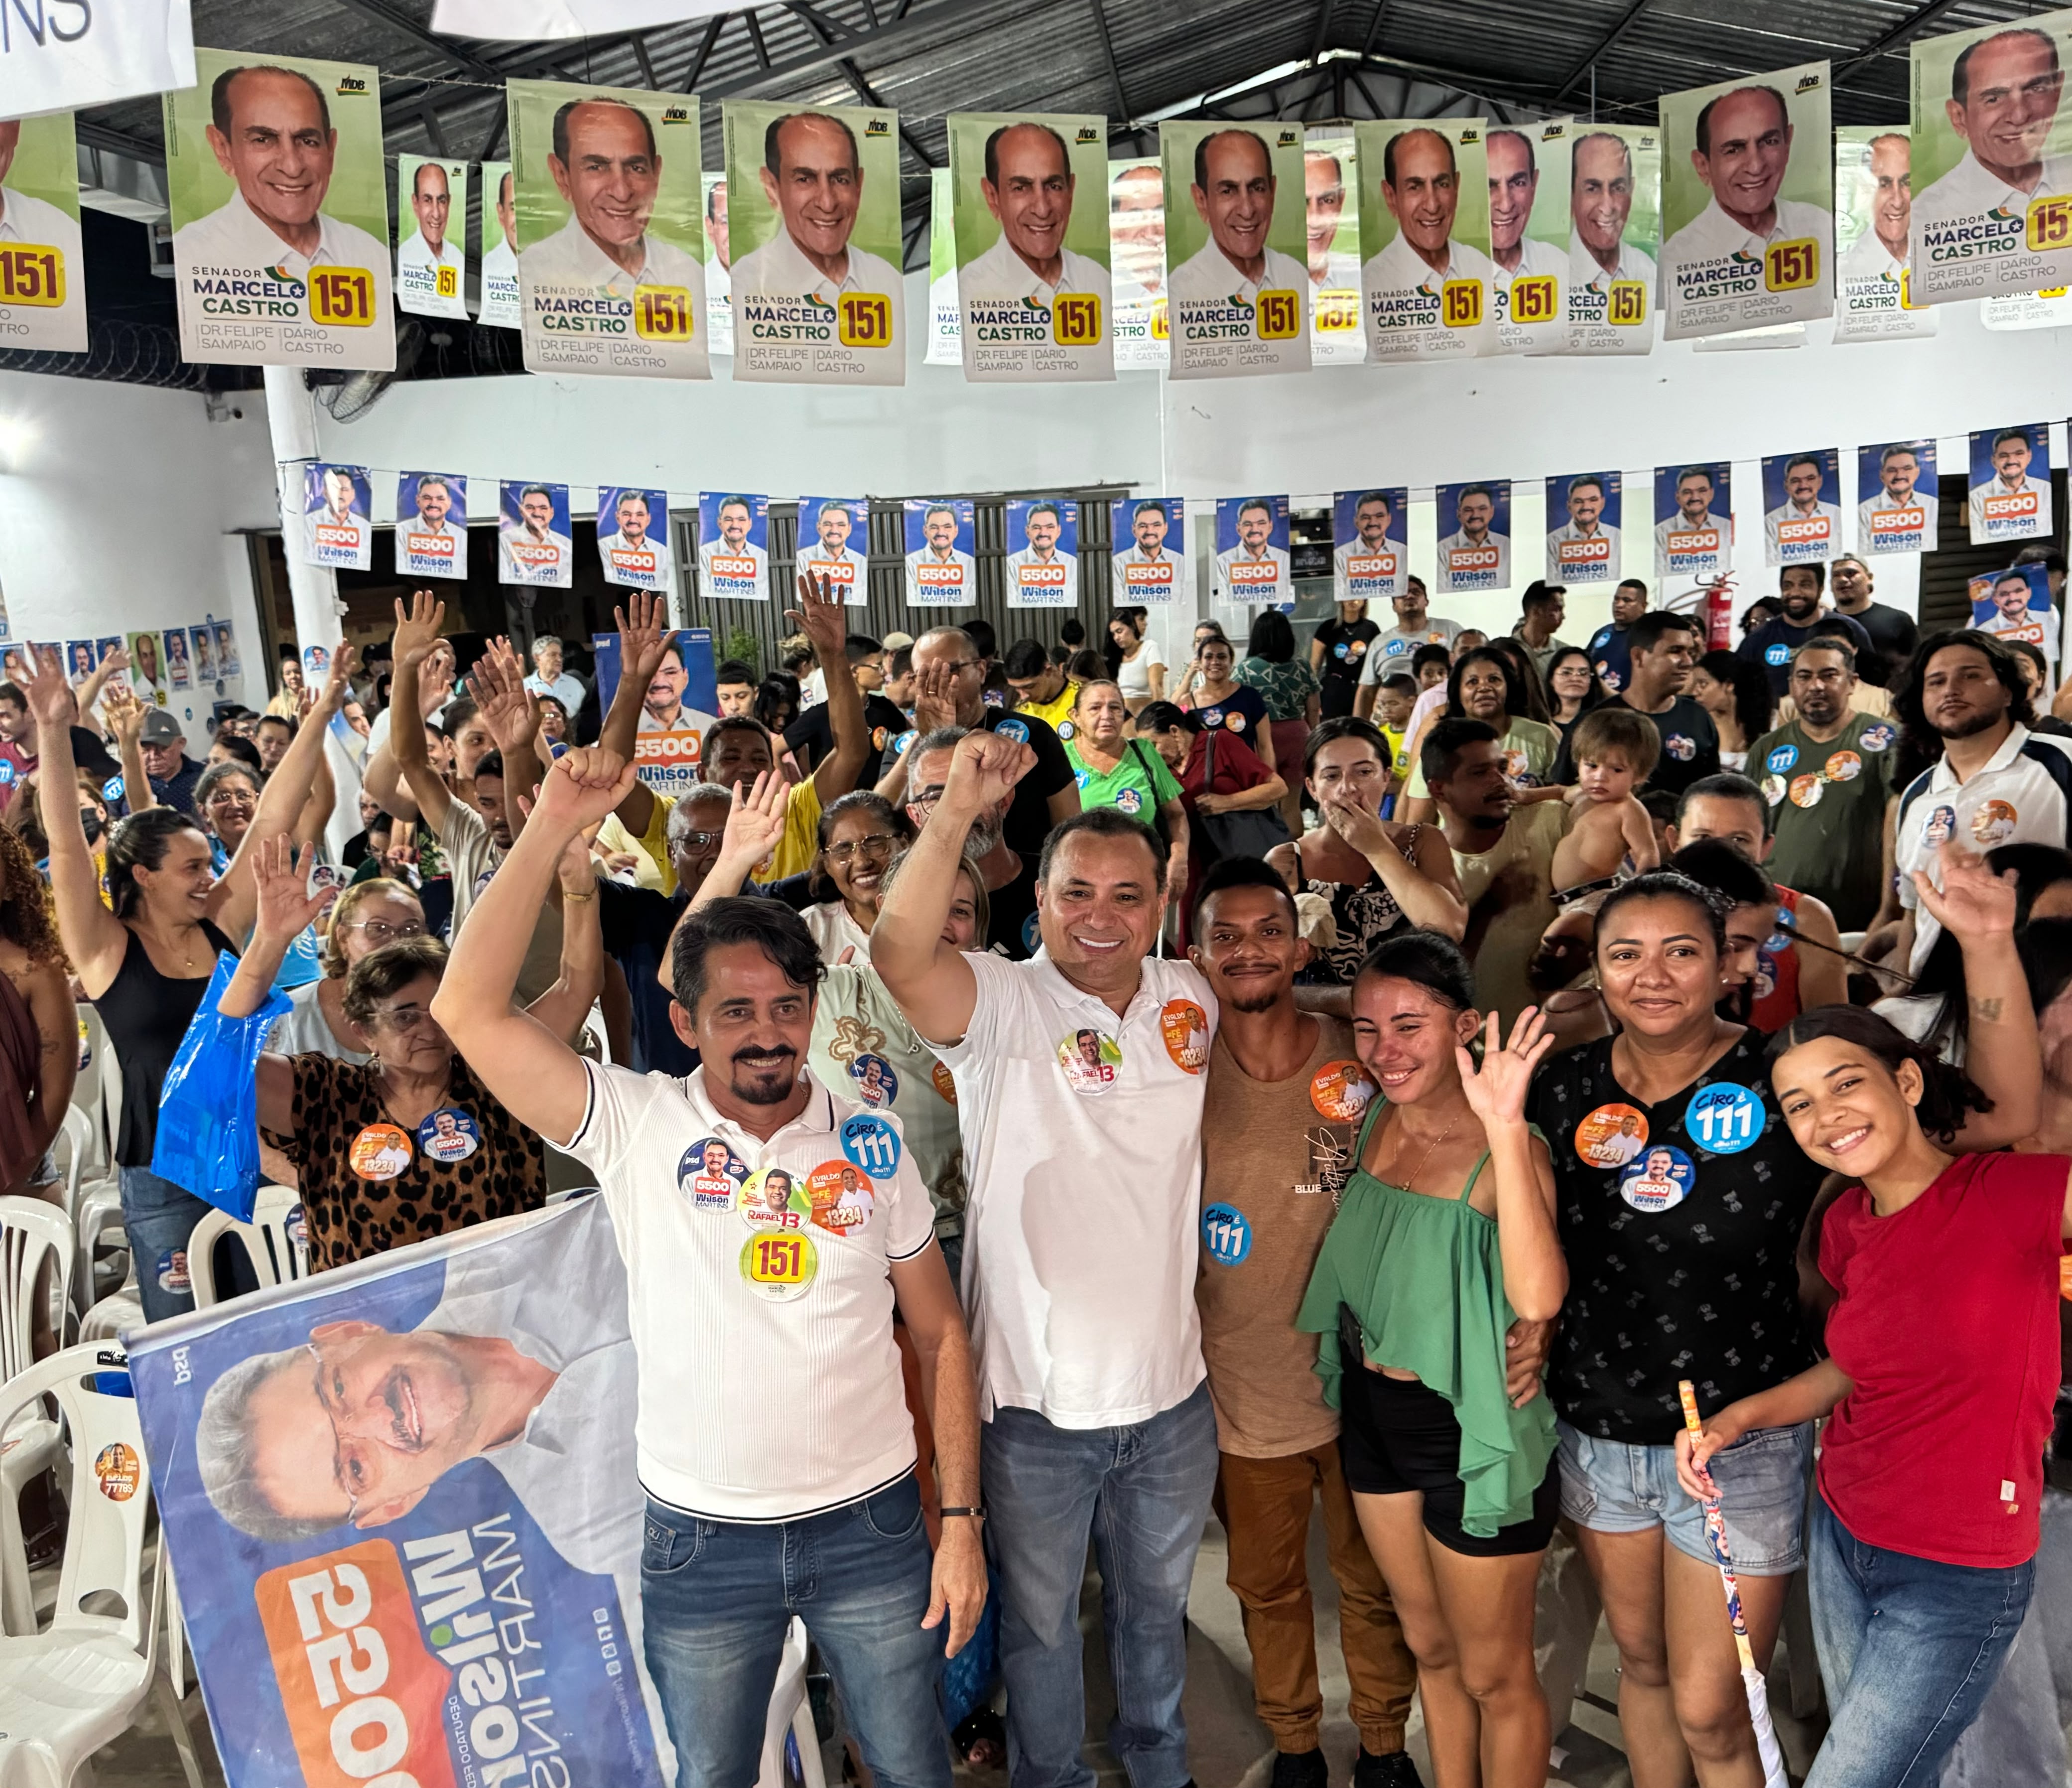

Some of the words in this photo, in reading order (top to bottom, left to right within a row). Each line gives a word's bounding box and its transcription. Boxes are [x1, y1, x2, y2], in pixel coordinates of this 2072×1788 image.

[341, 78, 365, 91] MDB
[1799, 75, 1819, 89] MDB
[665, 108, 687, 120] MDB
[868, 121, 888, 133] MDB
[1078, 128, 1097, 140] MDB
[1279, 132, 1295, 142] MDB
[1462, 130, 1477, 140] MDB
[1924, 215, 1985, 231] SENADOR
[1925, 219, 2024, 247] MARCELO
[1931, 237, 2016, 262] CASTRO
[1677, 259, 1729, 272] SENADOR
[1770, 244, 1813, 284] 151
[192, 267, 261, 277] SENADOR
[403, 270, 437, 282] MARCELO
[1678, 262, 1763, 286] MARCELO
[2001, 267, 2057, 282] CASTRO
[193, 279, 306, 298] MARCELO
[404, 279, 434, 291] CASTRO
[439, 270, 455, 294] 151
[1928, 277, 1984, 292] SAMPAIO
[534, 286, 594, 297] SENADOR
[1371, 290, 1414, 299] SENADOR
[1684, 278, 1757, 300] CASTRO
[1846, 282, 1899, 296] MARCELO
[314, 274, 368, 318] 151
[745, 296, 800, 304] SENADOR
[1515, 282, 1552, 317] 151
[1849, 296, 1896, 309] CASTRO
[203, 298, 298, 317] CASTRO
[534, 297, 632, 316] MARCELO
[1179, 300, 1226, 309] SENADOR
[1372, 298, 1440, 313] MARCELO
[1446, 286, 1478, 320] 151
[1613, 287, 1642, 319] 151
[640, 294, 686, 334] 151
[745, 307, 836, 323] MARCELO
[970, 310, 1050, 324] MARCELO
[1180, 306, 1255, 324] MARCELO
[1260, 296, 1295, 333] 151
[1744, 305, 1792, 319] CASTRO
[542, 315, 626, 333] CASTRO
[843, 301, 886, 339] 151
[1058, 301, 1096, 338] 151
[1378, 312, 1436, 328] CASTRO
[1680, 315, 1729, 328] SAMPAIO
[753, 324, 830, 340] CASTRO
[1186, 323, 1250, 339] CASTRO
[1846, 325, 1877, 334] SAMPAIO
[1886, 323, 1915, 331] CASTRO
[977, 327, 1045, 341] CASTRO
[202, 339, 266, 351] SAMPAIO
[284, 341, 344, 354] CASTRO
[1427, 341, 1465, 351] CASTRO
[1589, 339, 1624, 347] CASTRO
[542, 353, 598, 364] SAMPAIO
[614, 357, 666, 368] CASTRO
[1184, 359, 1228, 369] SAMPAIO
[1239, 355, 1279, 366] CASTRO
[750, 361, 802, 371] SAMPAIO
[817, 362, 865, 373] CASTRO
[977, 362, 1023, 371] SAMPAIO
[1036, 361, 1078, 371] CASTRO
[1987, 498, 2036, 515] 5500
[1874, 512, 1922, 529] 5500
[318, 528, 358, 544] 5500
[1781, 521, 1827, 539] 5500
[410, 537, 453, 552] 5500
[1670, 534, 1716, 549] 5500
[1874, 532, 1922, 545] Wilson
[318, 545, 357, 558] Wilson
[515, 547, 557, 560] 5500
[1562, 543, 1607, 558] 5500
[1782, 542, 1828, 554] Wilson
[410, 554, 452, 567] Wilson
[613, 553, 654, 567] 5500
[1452, 551, 1496, 566] 5500
[1671, 553, 1717, 565] Wilson
[713, 559, 754, 573] 5500
[1349, 558, 1394, 573] 5500
[1561, 563, 1607, 574] Wilson
[617, 568, 654, 581] Wilson
[919, 568, 961, 581] 5500
[1021, 569, 1063, 581] 5500
[1128, 567, 1170, 580] 5500
[1232, 566, 1276, 579] 5500
[1452, 570, 1496, 582] Wilson
[714, 577, 755, 588] Wilson
[1350, 578, 1394, 589] Wilson
[921, 586, 961, 596] Wilson
[1022, 587, 1063, 597] Wilson
[1129, 586, 1170, 595] Wilson
[1233, 585, 1276, 595] Wilson
[1164, 1012, 1185, 1021] EVALDO
[1097, 1065, 1114, 1082] 13
[1696, 1102, 1752, 1141] 111
[437, 1138, 464, 1148] 5500
[850, 1132, 895, 1167] 111
[1588, 1144, 1624, 1163] 13234
[364, 1159, 395, 1174] 13234
[812, 1173, 840, 1182] EVALDO
[697, 1180, 729, 1192] 5500
[1295, 1184, 1321, 1193] BLUE
[1636, 1183, 1669, 1194] 5500
[696, 1194, 728, 1204] Wilson
[1634, 1195, 1666, 1204] Wilson
[748, 1210, 780, 1221] RAFAEL
[780, 1212, 800, 1229] 13
[826, 1206, 863, 1227] 13234
[1207, 1221, 1244, 1256] 111
[758, 1241, 800, 1276] 151
[106, 1484, 132, 1496] 77789
